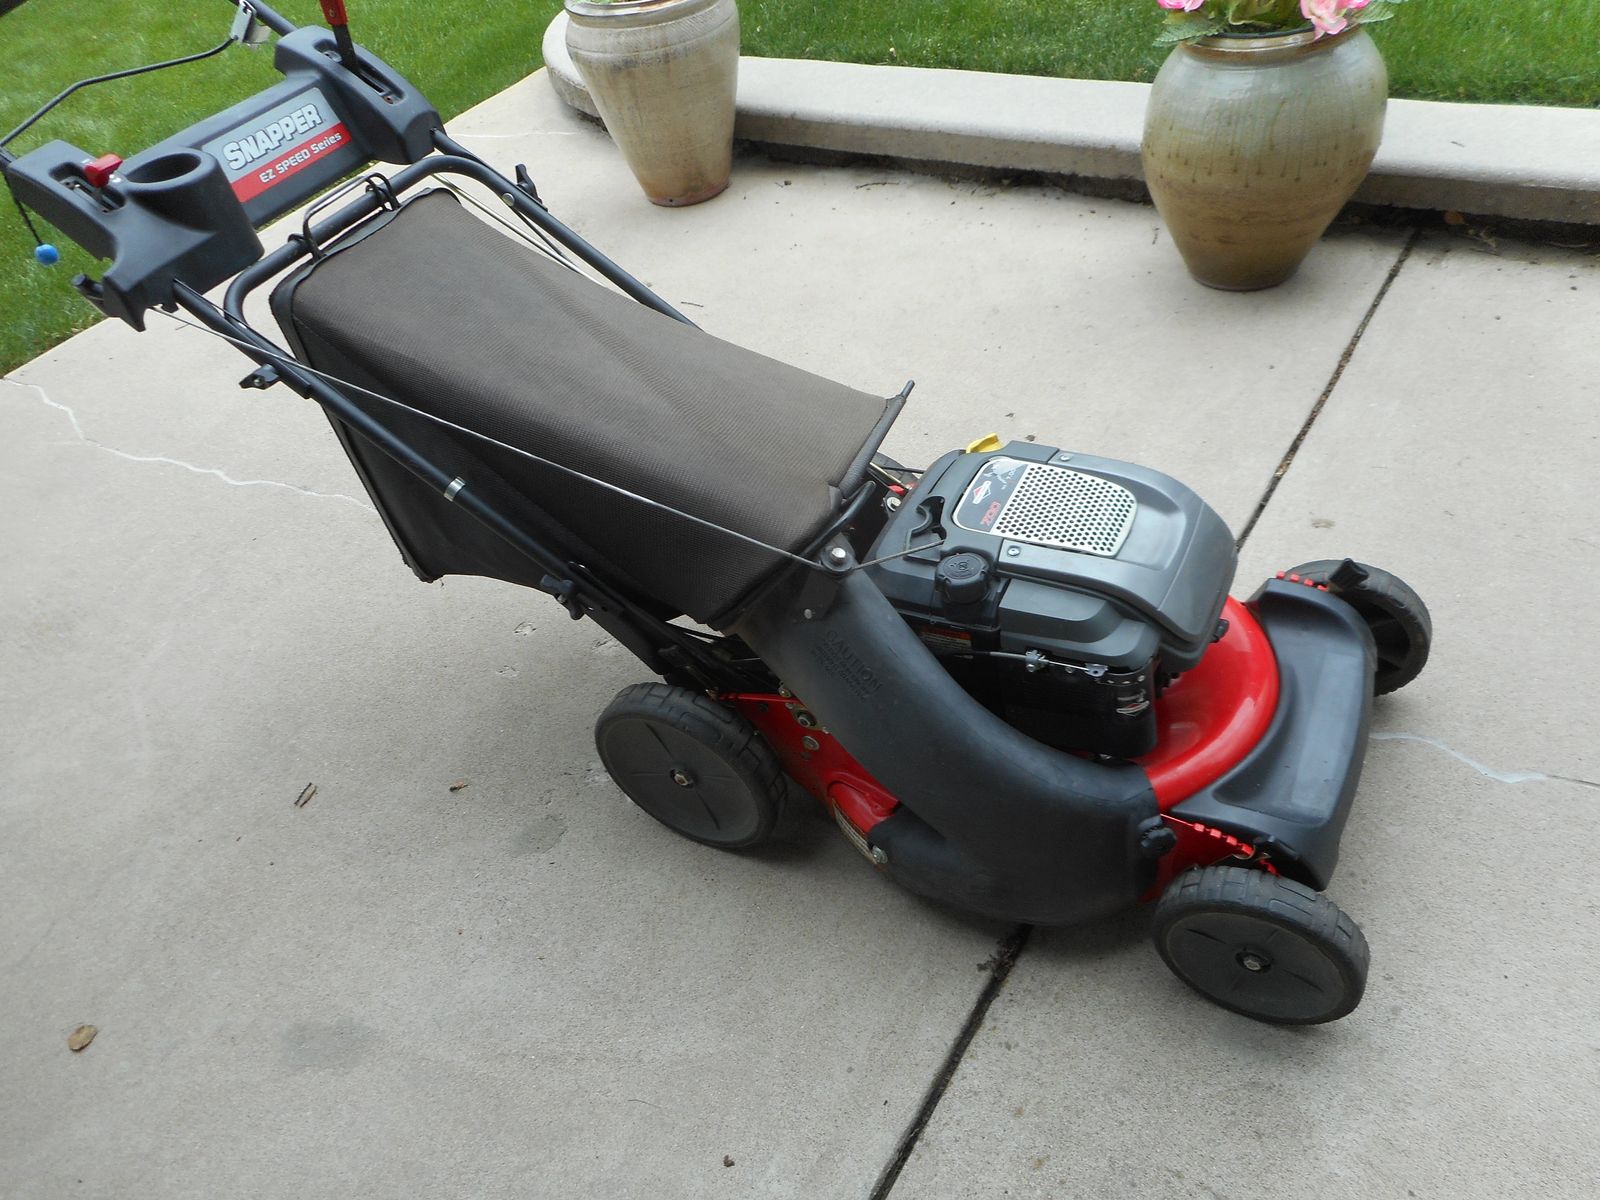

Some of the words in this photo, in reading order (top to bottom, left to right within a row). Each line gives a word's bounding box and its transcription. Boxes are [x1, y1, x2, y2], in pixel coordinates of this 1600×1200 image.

[223, 103, 324, 170] SNAPPER
[259, 168, 276, 183] EZ
[275, 149, 311, 174] SPEED
[310, 132, 342, 154] Series
